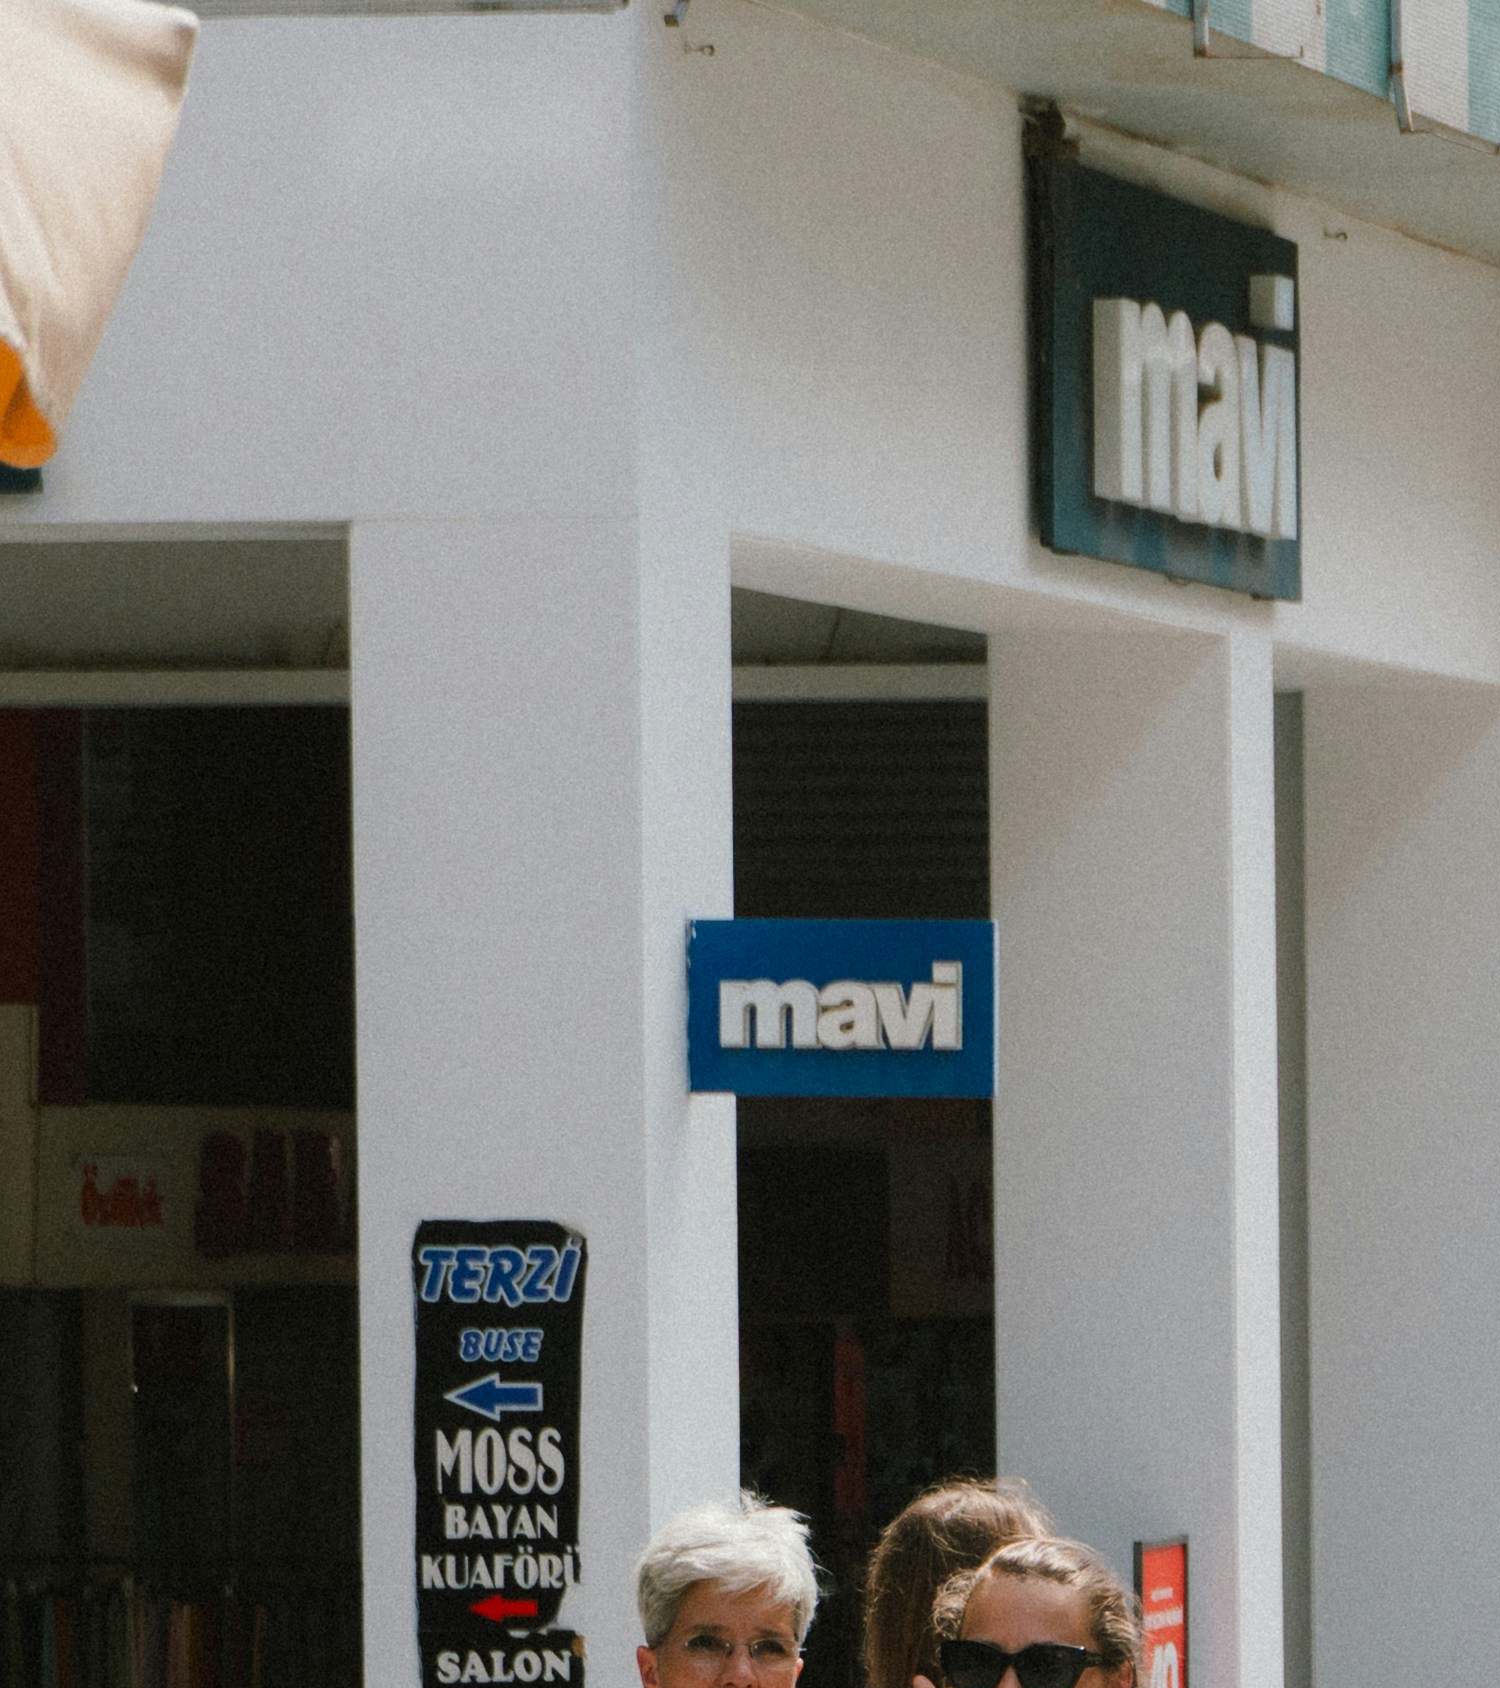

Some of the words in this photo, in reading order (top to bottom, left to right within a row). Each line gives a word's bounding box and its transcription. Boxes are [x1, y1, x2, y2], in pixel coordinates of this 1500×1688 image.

[1094, 274, 1297, 541] mavi
[719, 960, 963, 1050] mavi
[419, 1236, 581, 1307] TERZİ
[460, 1328, 543, 1362] BUSE
[436, 1426, 564, 1495] MOSS
[444, 1504, 558, 1540] BAYAN
[437, 1650, 571, 1683] SALON
